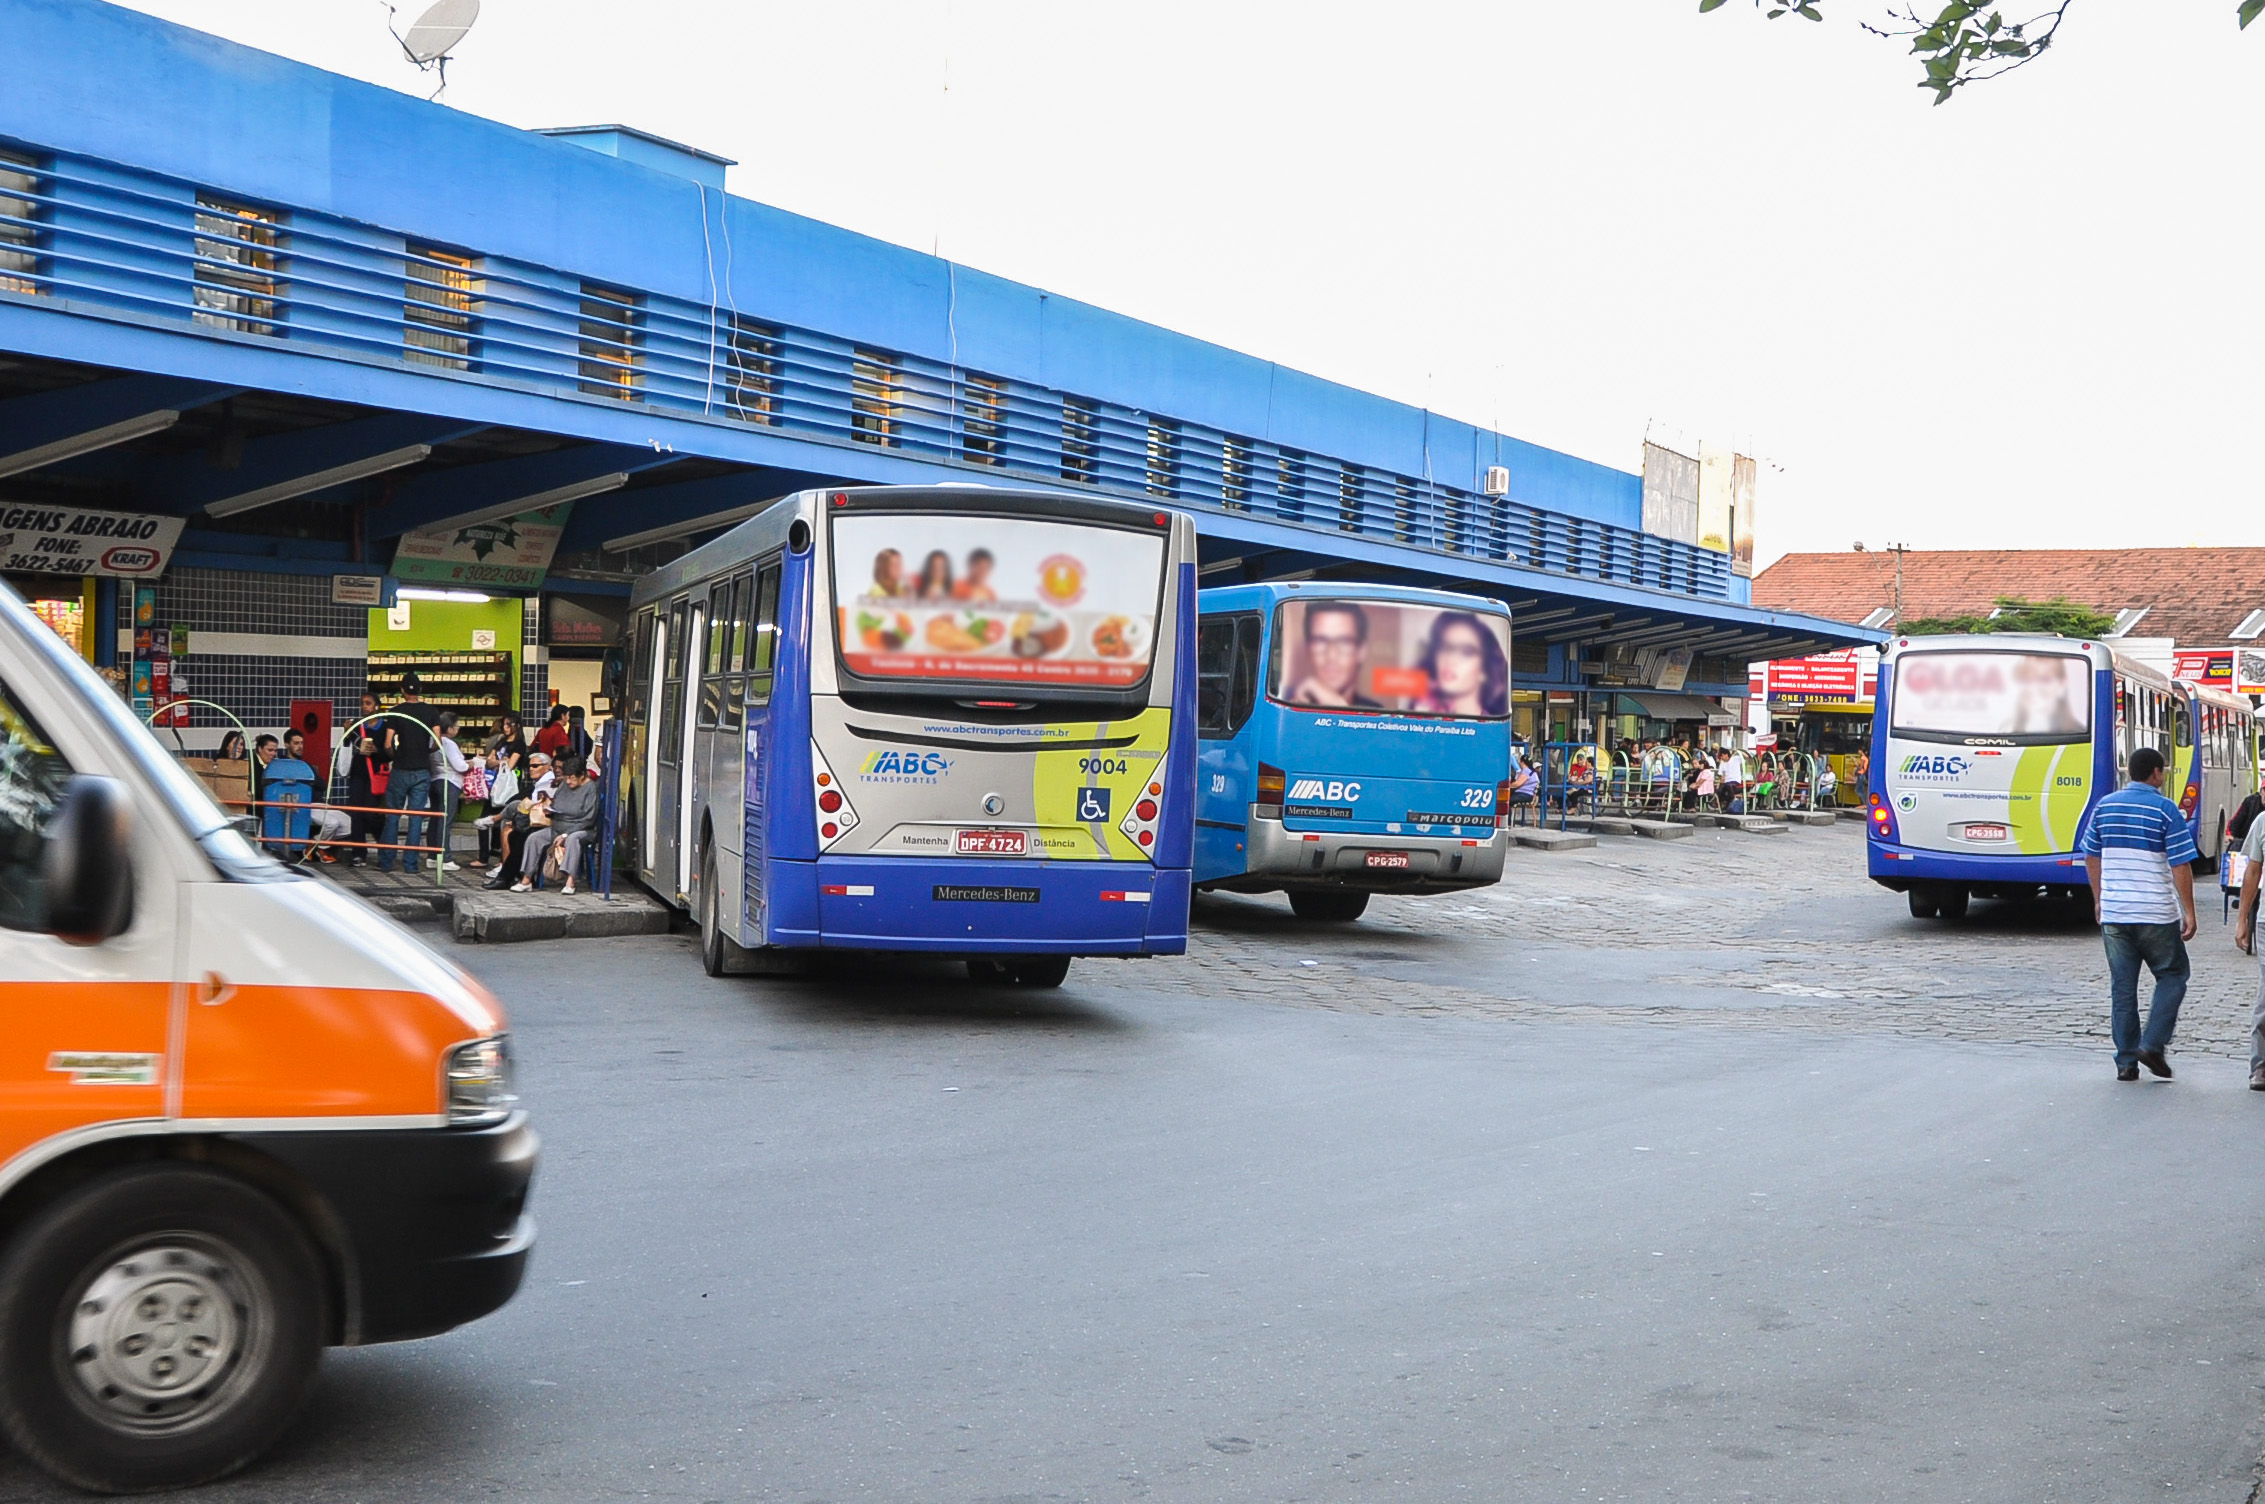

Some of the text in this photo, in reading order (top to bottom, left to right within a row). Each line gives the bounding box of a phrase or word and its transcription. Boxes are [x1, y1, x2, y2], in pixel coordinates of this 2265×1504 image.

[34, 537, 82, 554] FONE:
[5, 553, 96, 573] 3622-5467
[111, 552, 152, 566] KRAFT
[464, 565, 536, 585] 3022-0341
[924, 725, 1070, 737] www.abctransportes.com.br
[1964, 738, 2016, 746] COMIL
[1079, 757, 1127, 775] 9004
[859, 775, 938, 784] TRANSPORTES
[1211, 774, 1225, 793] 329
[1899, 774, 1960, 782] TRANSPORTES
[2056, 776, 2082, 787] 8018
[1460, 788, 1493, 808] 329
[1943, 792, 2032, 801] www.abctransportes.com.br
[1288, 805, 1350, 818] Mercedes-Benz
[902, 836, 949, 846] Mantenha
[1033, 838, 1076, 849] Distância
[938, 886, 1035, 902] Mercedes-Benz
